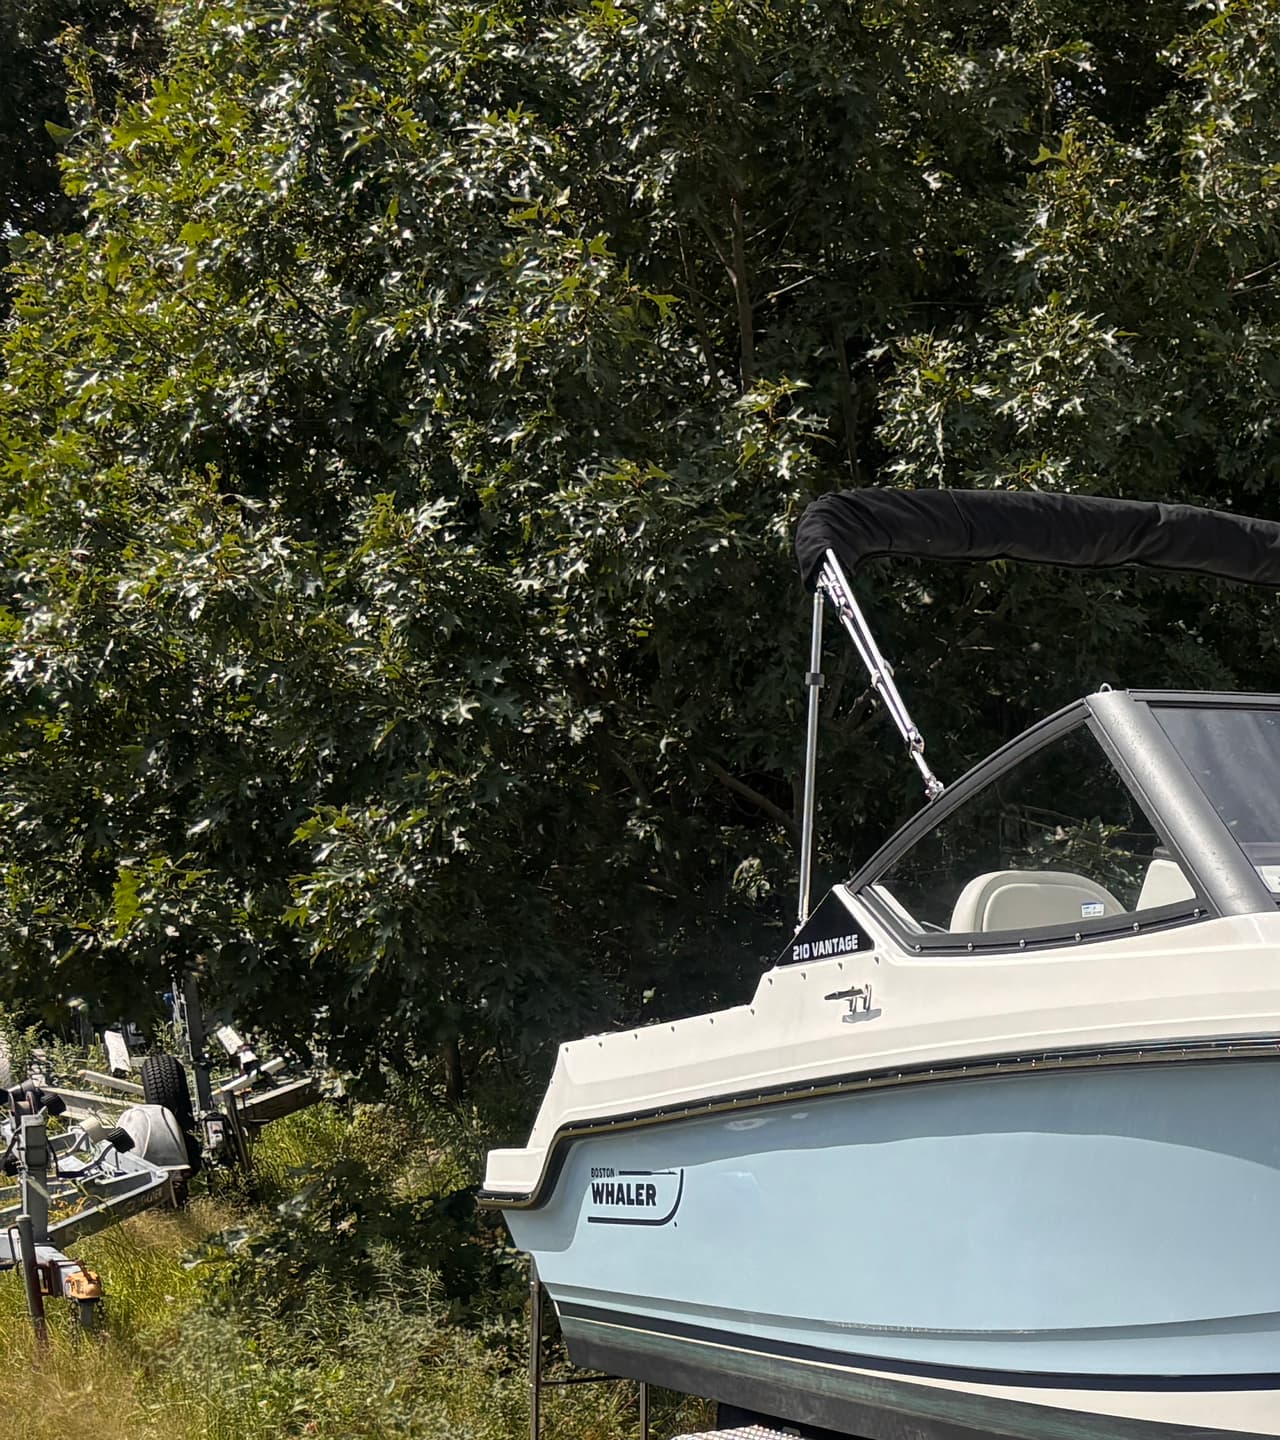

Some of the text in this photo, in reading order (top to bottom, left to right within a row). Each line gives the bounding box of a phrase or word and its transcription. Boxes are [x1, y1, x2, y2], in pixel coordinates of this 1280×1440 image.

[793, 934, 859, 960] 210 VANTAGE
[590, 1167, 615, 1178] BOSTON
[591, 1182, 657, 1206] WHALER
